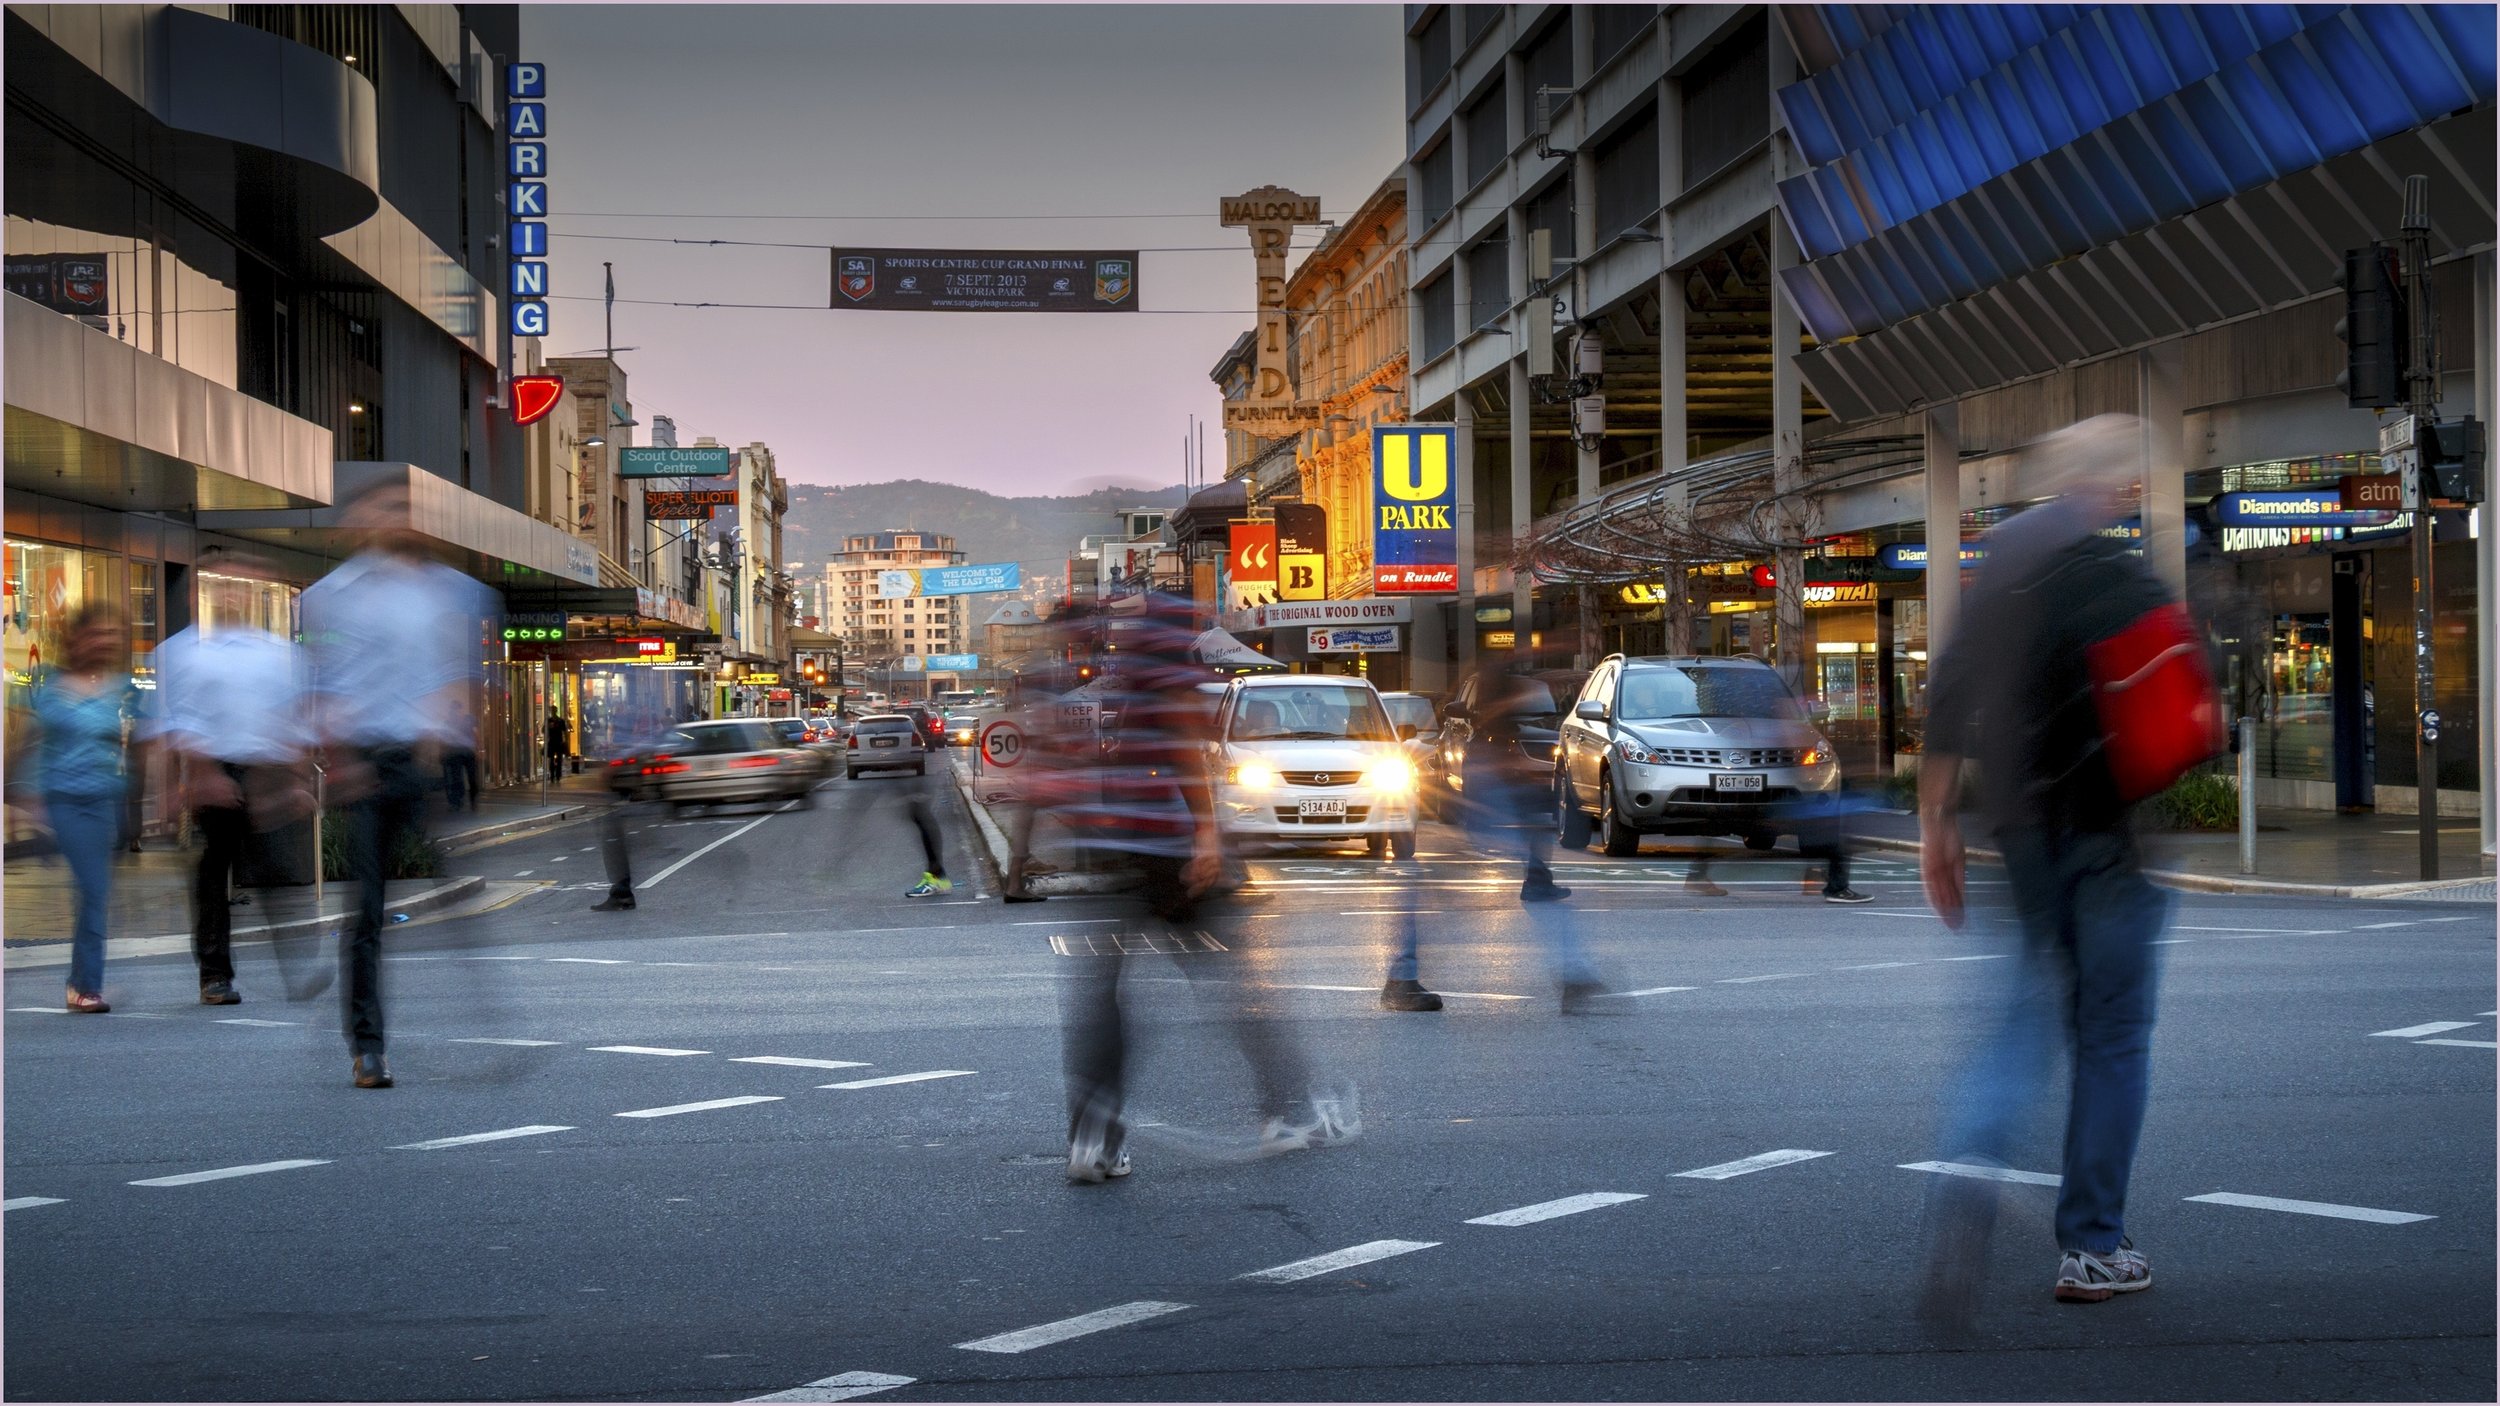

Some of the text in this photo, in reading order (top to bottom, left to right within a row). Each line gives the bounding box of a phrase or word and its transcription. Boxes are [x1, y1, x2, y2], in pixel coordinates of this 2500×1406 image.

[514, 66, 543, 333] PARKING
[1224, 202, 1318, 221] MALCOLM
[848, 260, 865, 270] SA
[885, 258, 1087, 270] SPORTS CENTRE CUP GRAND FINAL
[1100, 264, 1128, 275] NRL
[945, 274, 1027, 287] 7 SEPT. 2013
[945, 286, 1026, 297] VICTORIA PARK
[932, 299, 1039, 308] www.sarugbyleague.com.au
[1257, 228, 1286, 398] REID
[1227, 406, 1320, 421] FURNITURE
[628, 450, 722, 461] Scout Outdoor
[654, 463, 697, 473] Centre
[1383, 434, 1447, 501] U
[646, 491, 733, 504] SUPER ELLIOTT
[2360, 482, 2401, 501] atm
[650, 503, 701, 519] Cycles
[2239, 498, 2320, 514] Diamonds
[1380, 505, 1452, 530] PARK
[2092, 525, 2130, 537] onds
[1897, 549, 1927, 561] Diam
[942, 568, 1002, 579] WELCOME TO
[1289, 566, 1314, 589] B
[1380, 571, 1453, 583] on Rundle
[942, 576, 1005, 587] THE EAST END
[504, 613, 560, 624] PARKING
[1269, 604, 1396, 621] THE ORIGINAL WOOD OVEN
[1064, 706, 1093, 716] KEEP
[990, 734, 1019, 755] 50
[1718, 777, 1760, 788] XGT 058
